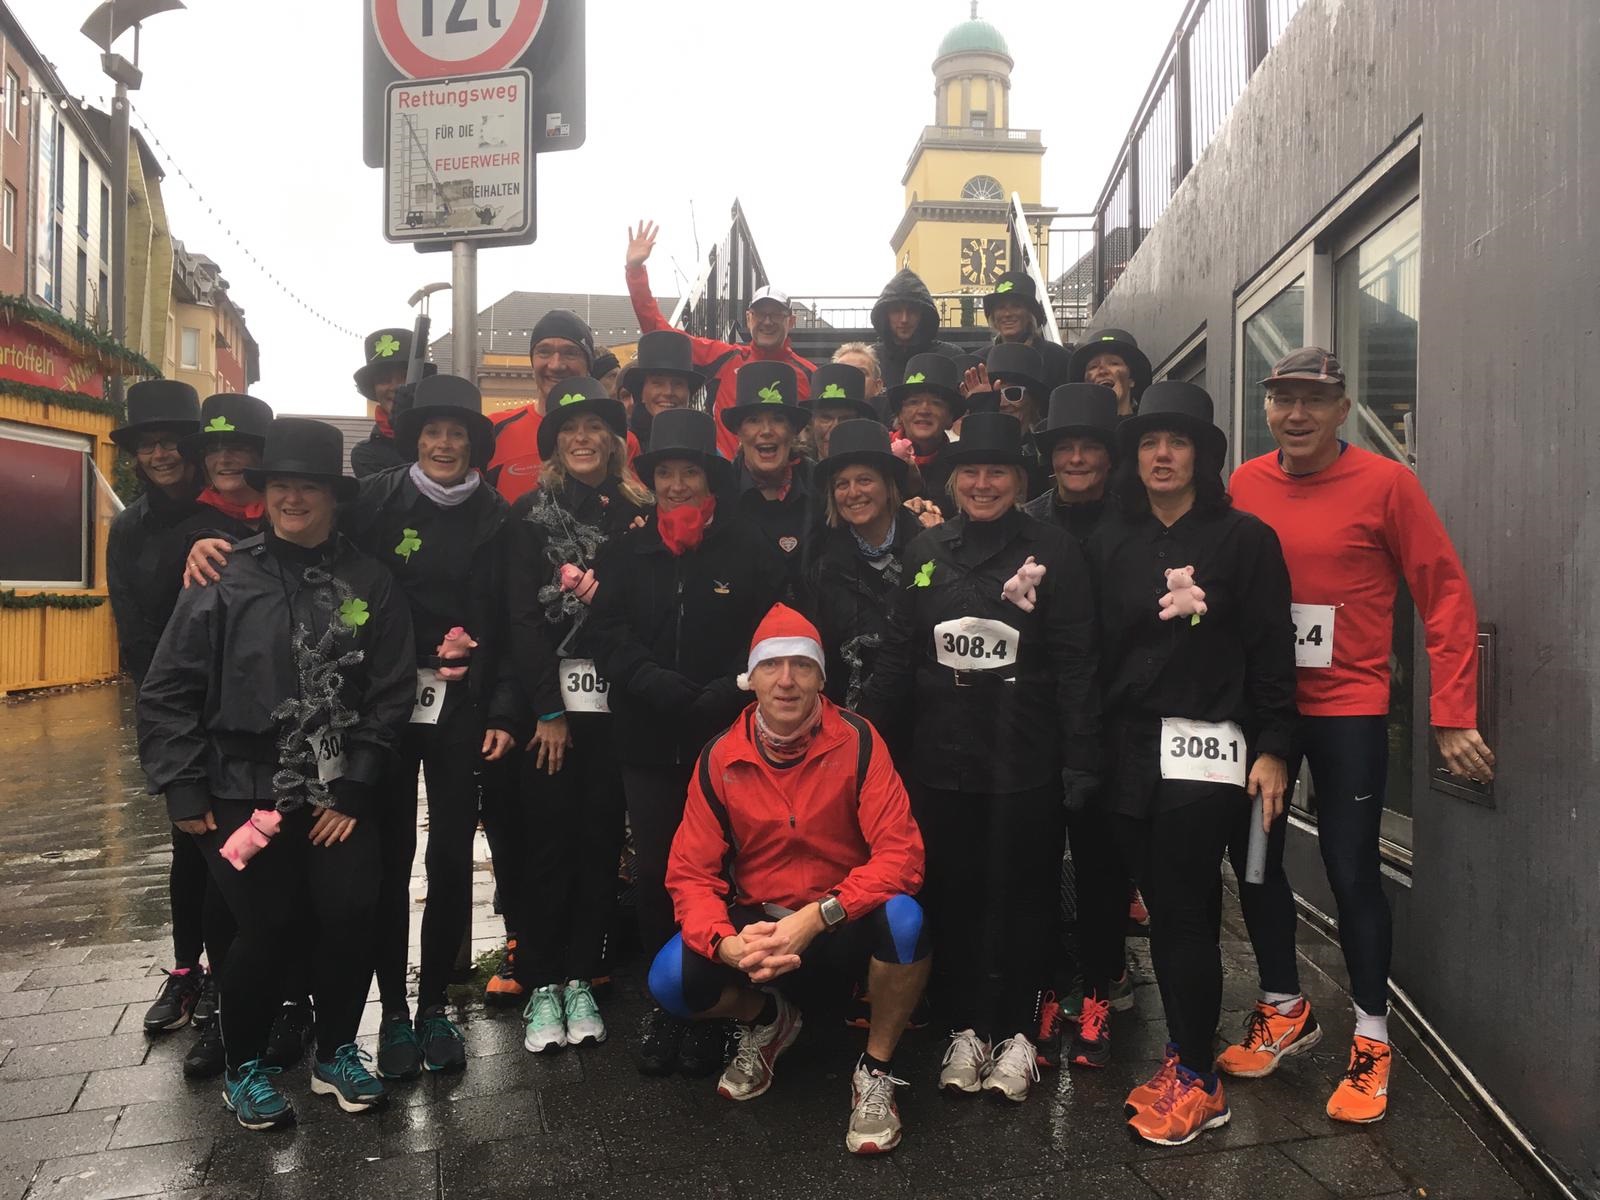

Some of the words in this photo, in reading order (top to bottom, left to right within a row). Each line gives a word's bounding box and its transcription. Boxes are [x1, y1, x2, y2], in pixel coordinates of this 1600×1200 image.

[399, 85, 518, 108] Rettungsweg
[435, 124, 454, 140] FÜR
[459, 124, 474, 138] DIE
[435, 152, 520, 172] FEUERWEHR
[462, 182, 520, 199] FREIHALTEN
[942, 632, 1008, 660] 308.4
[567, 672, 608, 694] 305
[1170, 736, 1239, 763] 308.1
